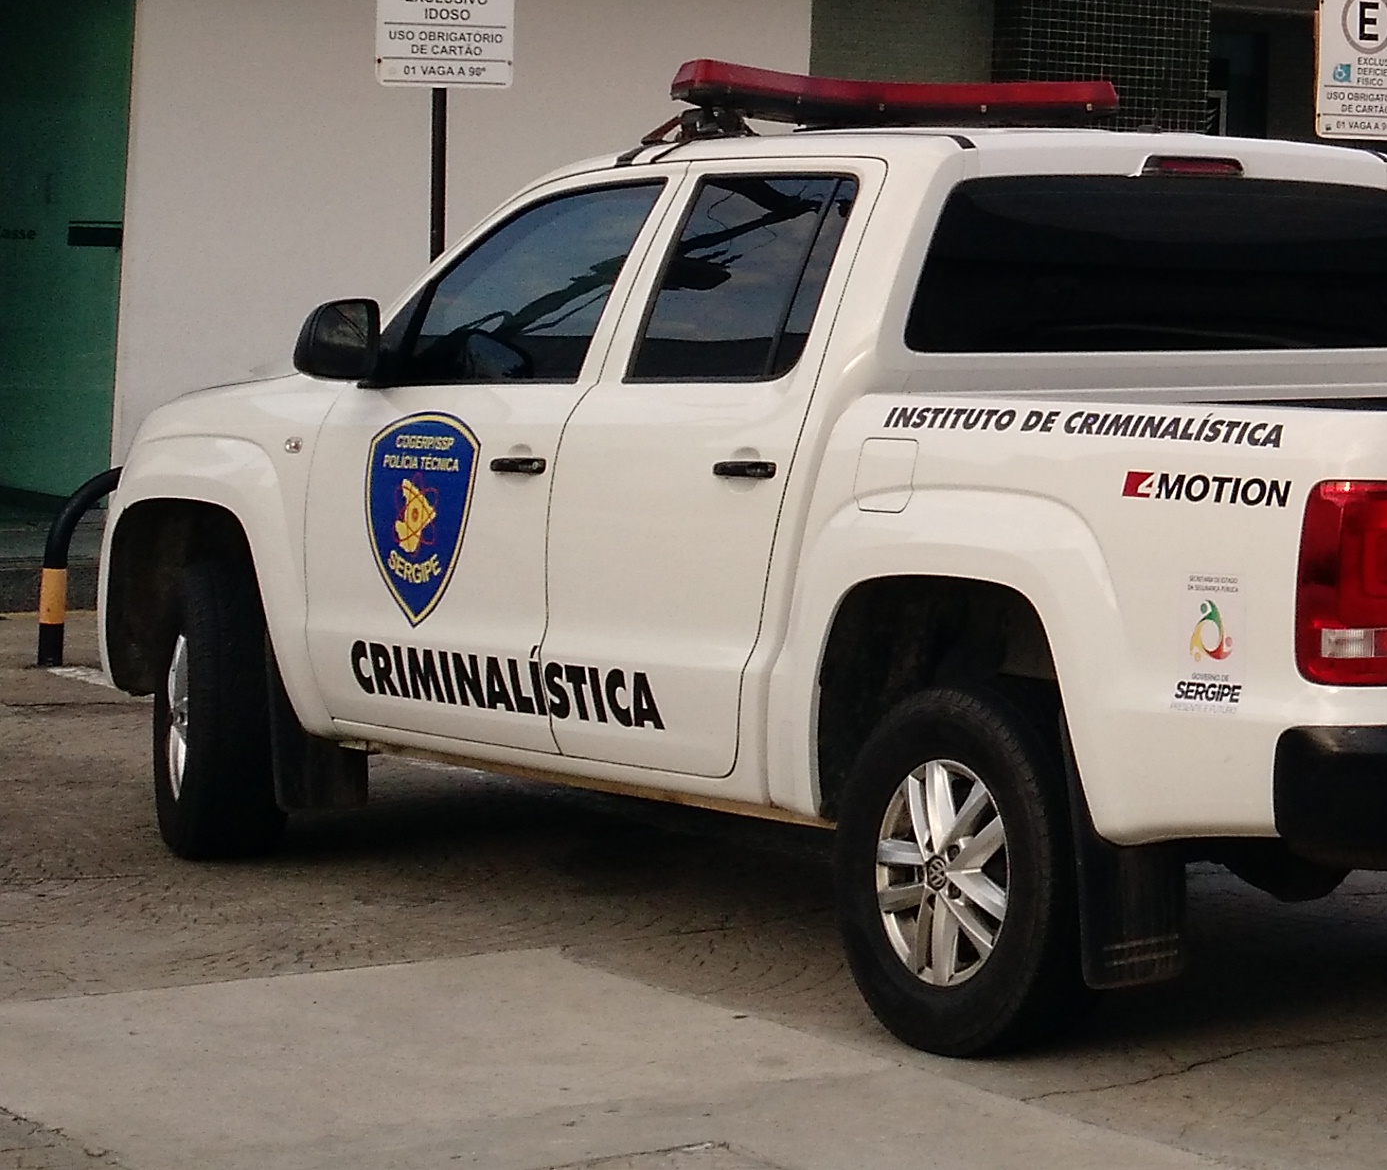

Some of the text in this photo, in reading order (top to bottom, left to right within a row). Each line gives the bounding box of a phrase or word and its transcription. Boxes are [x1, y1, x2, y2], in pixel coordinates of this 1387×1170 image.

[424, 8, 471, 21] IDOSO
[1359, 1, 1380, 42] E
[389, 30, 415, 41] USO
[411, 44, 483, 56] DE CARTÃO
[404, 65, 416, 75] 01
[422, 65, 454, 76] VAGA
[457, 67, 465, 77] A
[1326, 92, 1346, 101] USO
[1341, 104, 1354, 113] DE
[1348, 121, 1372, 130] VAGA
[1374, 122, 1382, 130] A
[883, 406, 1284, 448] INSTITUTO DE CRIMINALÍSTICA
[383, 452, 459, 472] POLÍCIA TÉCNICA
[388, 549, 442, 584] SERGIPE
[1191, 672, 1220, 681] GOVERNO
[350, 640, 666, 730] CRIMINALÍSTICA
[1174, 680, 1242, 703] SERGIPE
